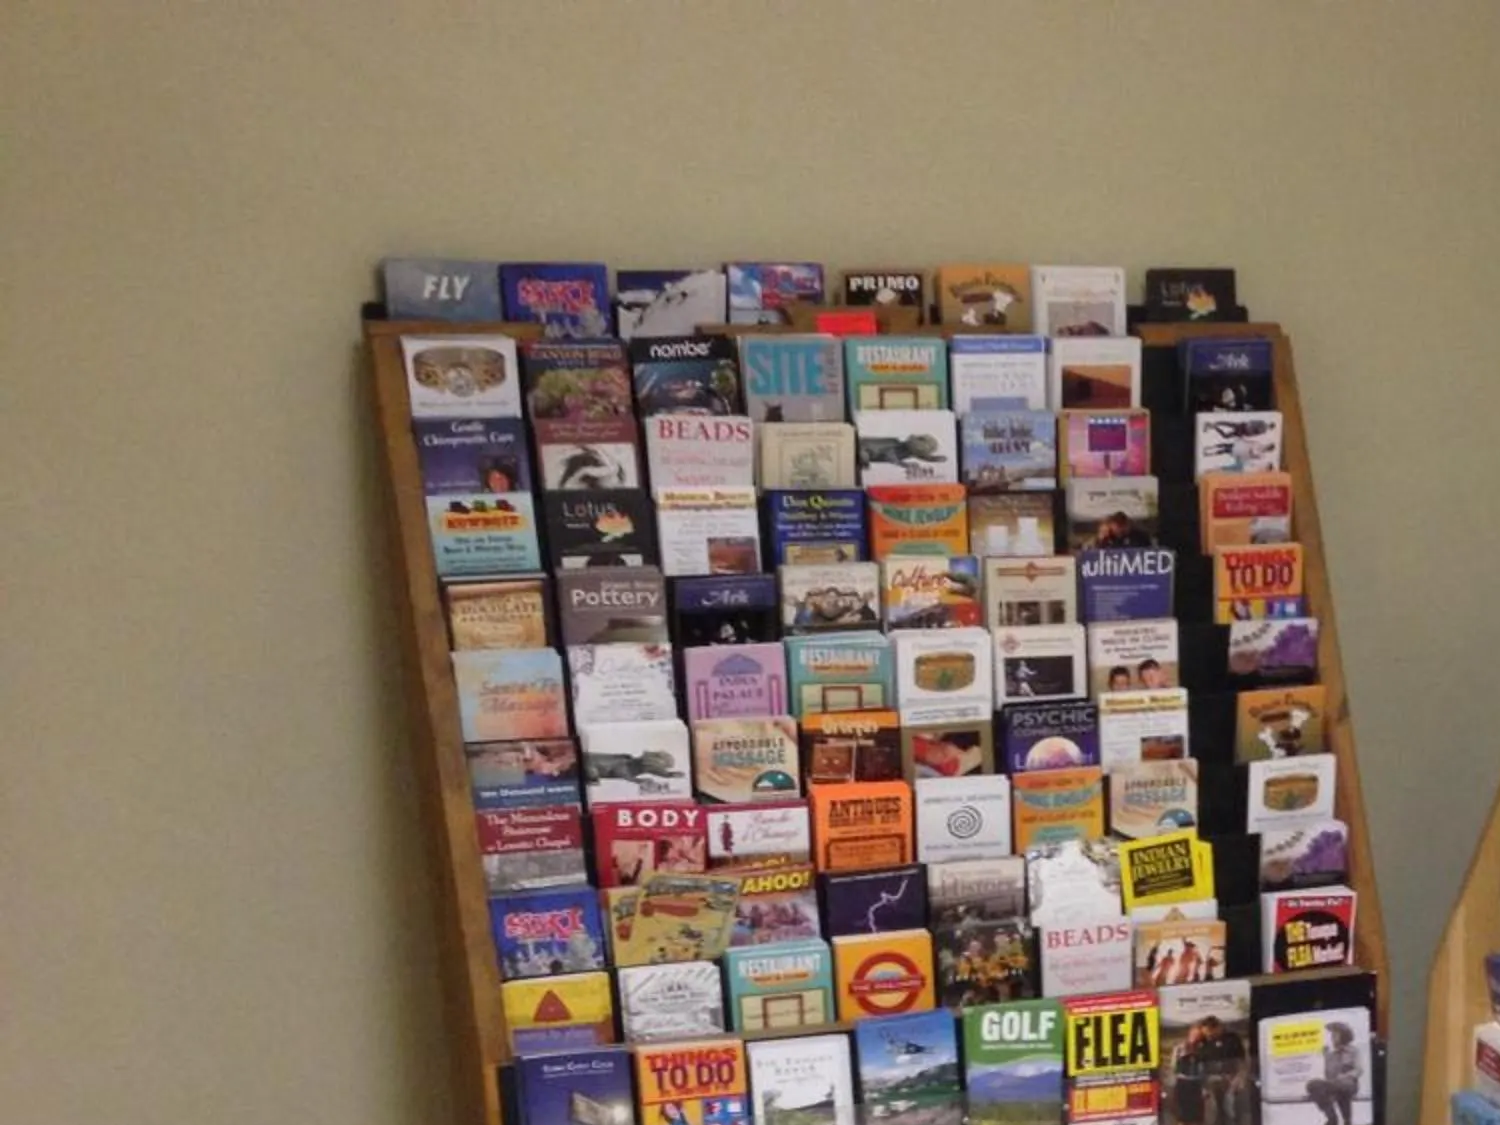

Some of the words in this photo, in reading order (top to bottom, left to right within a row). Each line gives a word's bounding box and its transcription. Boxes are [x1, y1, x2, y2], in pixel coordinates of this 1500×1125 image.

[423, 275, 471, 300] FLY
[850, 276, 920, 291] PRIMO
[747, 341, 826, 396] SITE
[659, 418, 750, 441] BEADS
[1229, 565, 1256, 588] TO
[1263, 562, 1294, 587] DO
[570, 589, 659, 607] Pottery
[1013, 708, 1095, 726] PSYCHIC
[617, 809, 699, 827] BODY
[1132, 843, 1187, 865] INDIAN
[742, 870, 810, 894] AHOO!
[1132, 857, 1191, 882] JEWELRY
[1046, 923, 1130, 950] BEADS
[981, 1010, 1057, 1042] GOLF
[1074, 1010, 1151, 1070] FLEA
[651, 1066, 688, 1091] TO
[696, 1060, 734, 1087] DO
